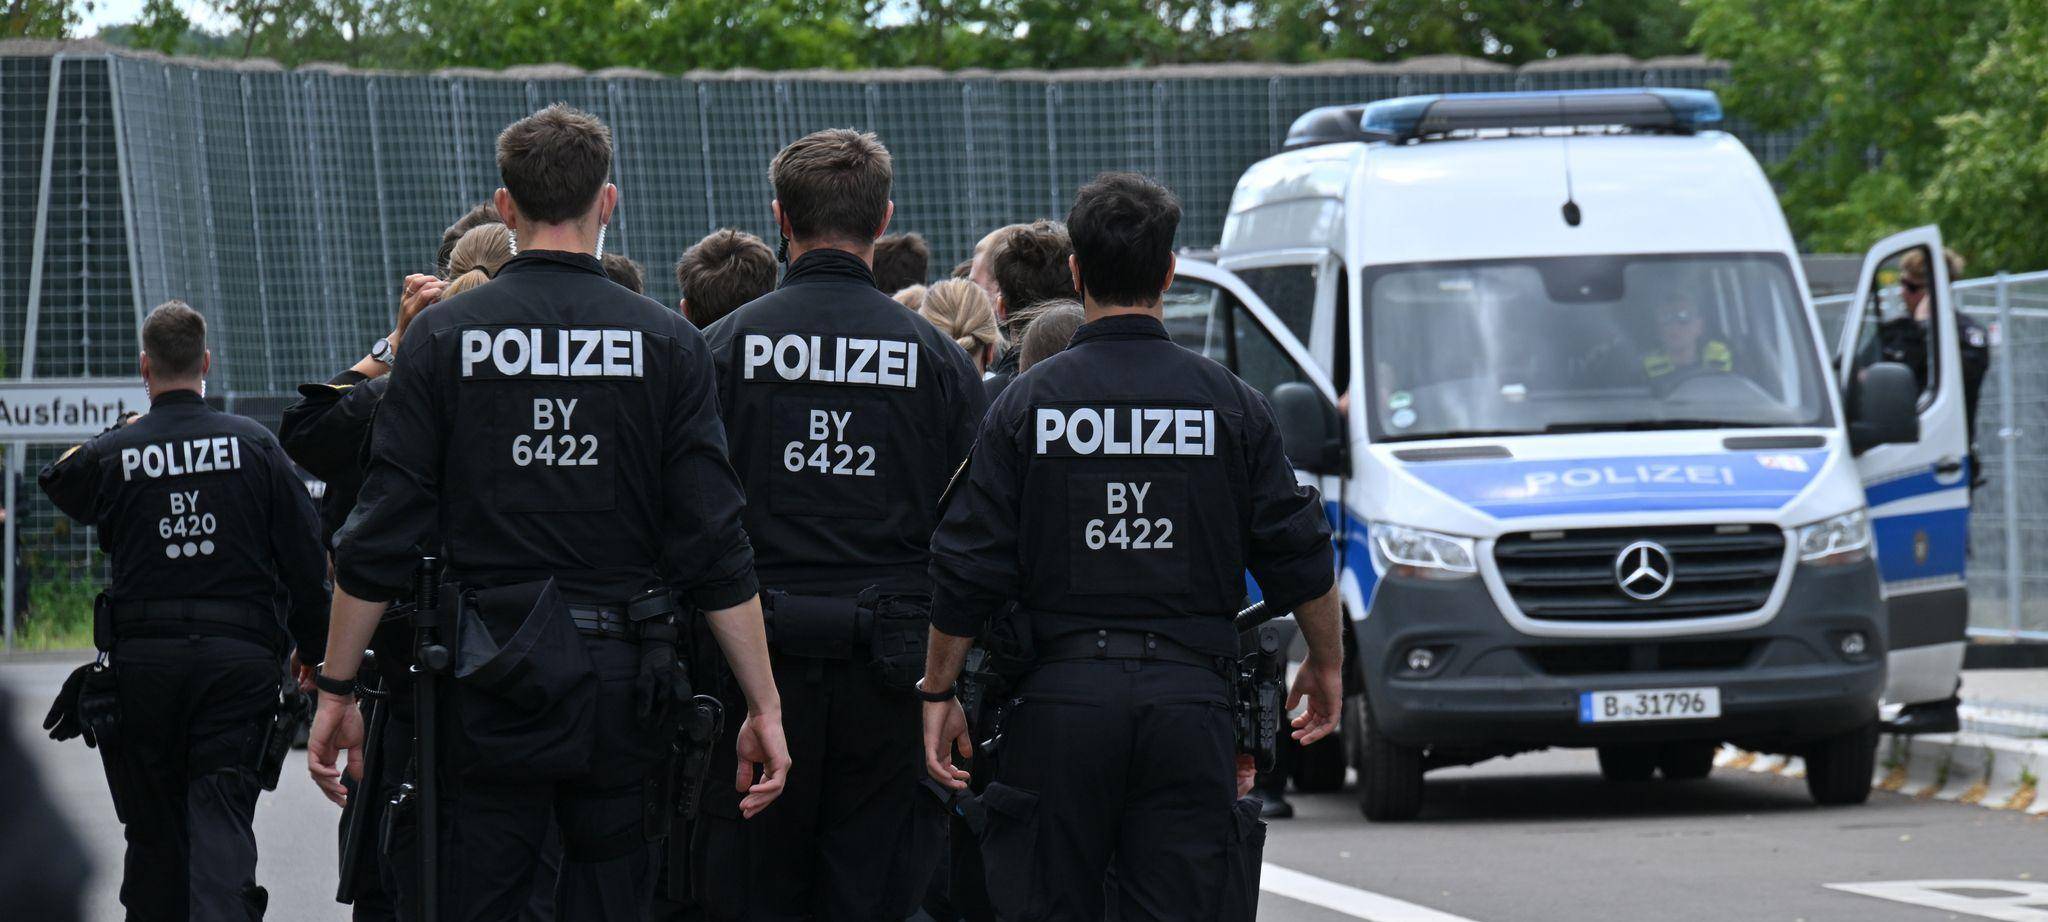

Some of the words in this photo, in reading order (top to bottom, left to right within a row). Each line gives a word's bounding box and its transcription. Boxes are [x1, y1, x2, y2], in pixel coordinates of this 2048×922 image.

[461, 328, 644, 378] POLIZEI
[744, 333, 919, 388] POLIZEI
[533, 398, 578, 431] BY
[809, 409, 853, 442] BY
[1036, 407, 1215, 456] POLIZEI
[121, 436, 241, 482] POLIZEI
[512, 434, 598, 467] 6422
[783, 440, 876, 477] 6422
[1524, 464, 1735, 496] POLIZEI
[169, 490, 199, 515] BY
[1107, 481, 1152, 515] BY
[158, 512, 217, 539] 6420
[1085, 517, 1173, 550] 6422
[1604, 696, 1618, 716] B
[1635, 693, 1705, 715] 31796
